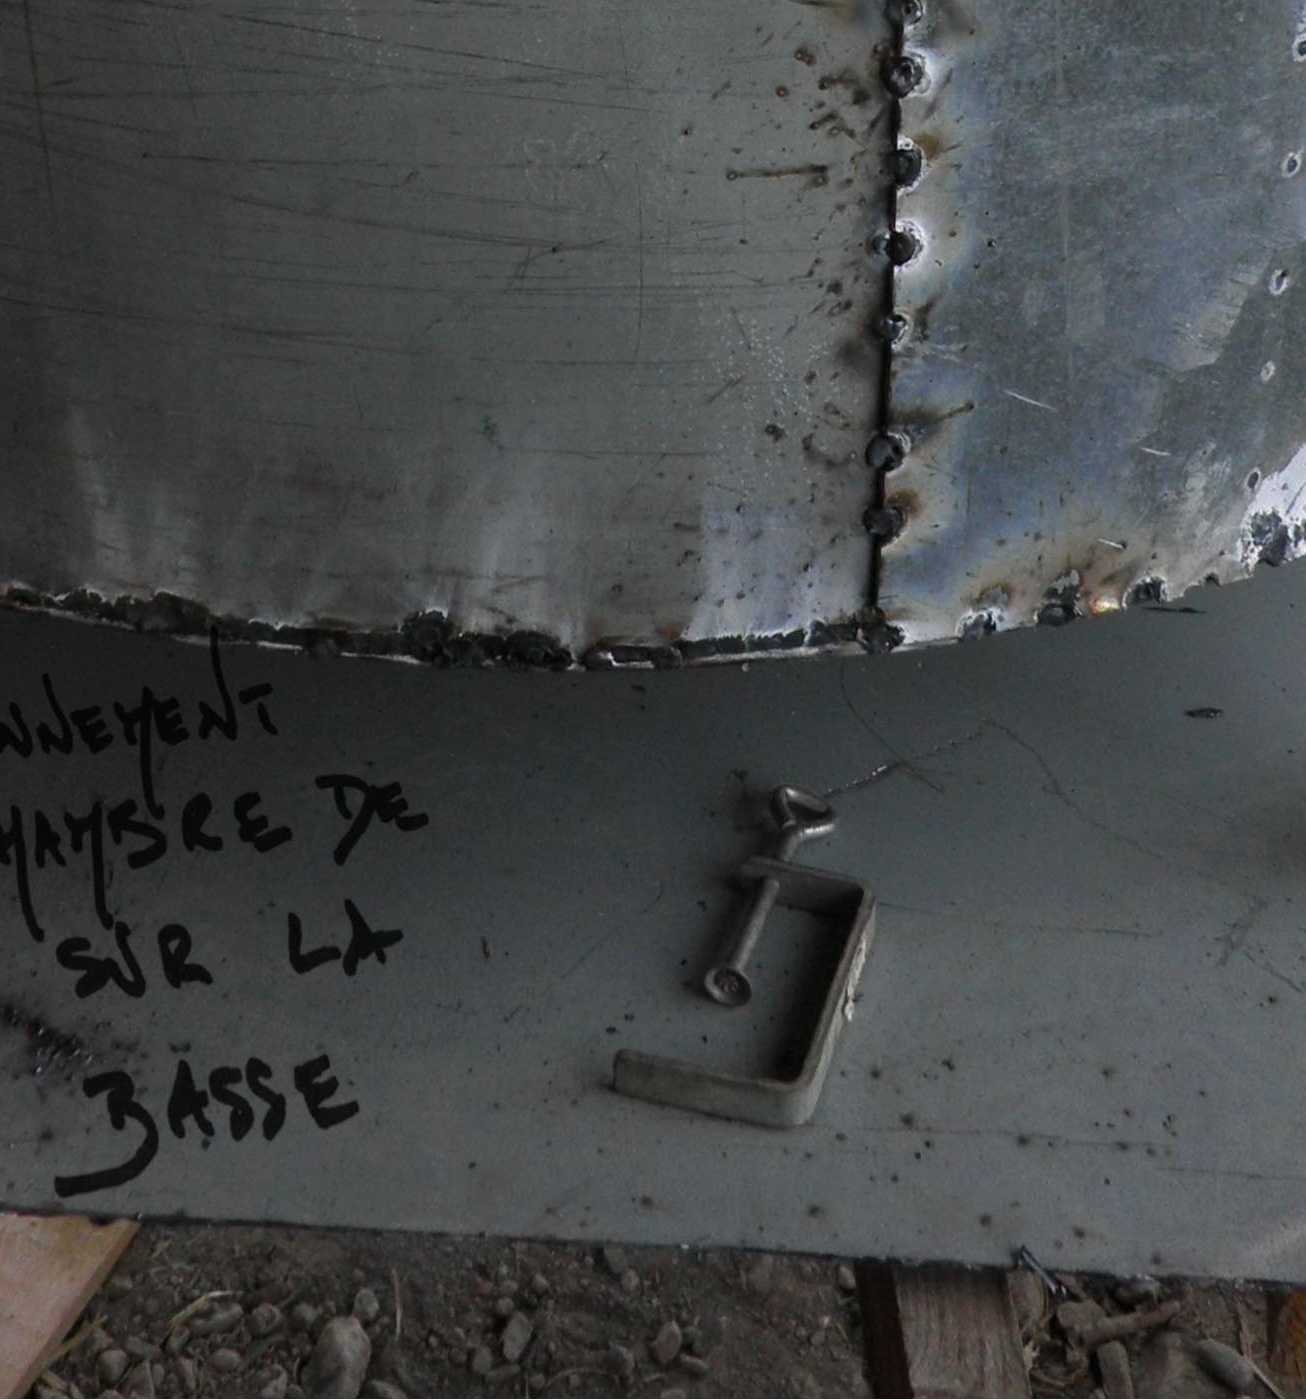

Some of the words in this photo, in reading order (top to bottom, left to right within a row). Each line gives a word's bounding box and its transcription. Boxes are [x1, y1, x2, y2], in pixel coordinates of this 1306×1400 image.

[315, 773, 430, 865] DE
[55, 918, 213, 998] SUR
[287, 898, 404, 976] LA
[53, 1054, 360, 1197] BASSE
